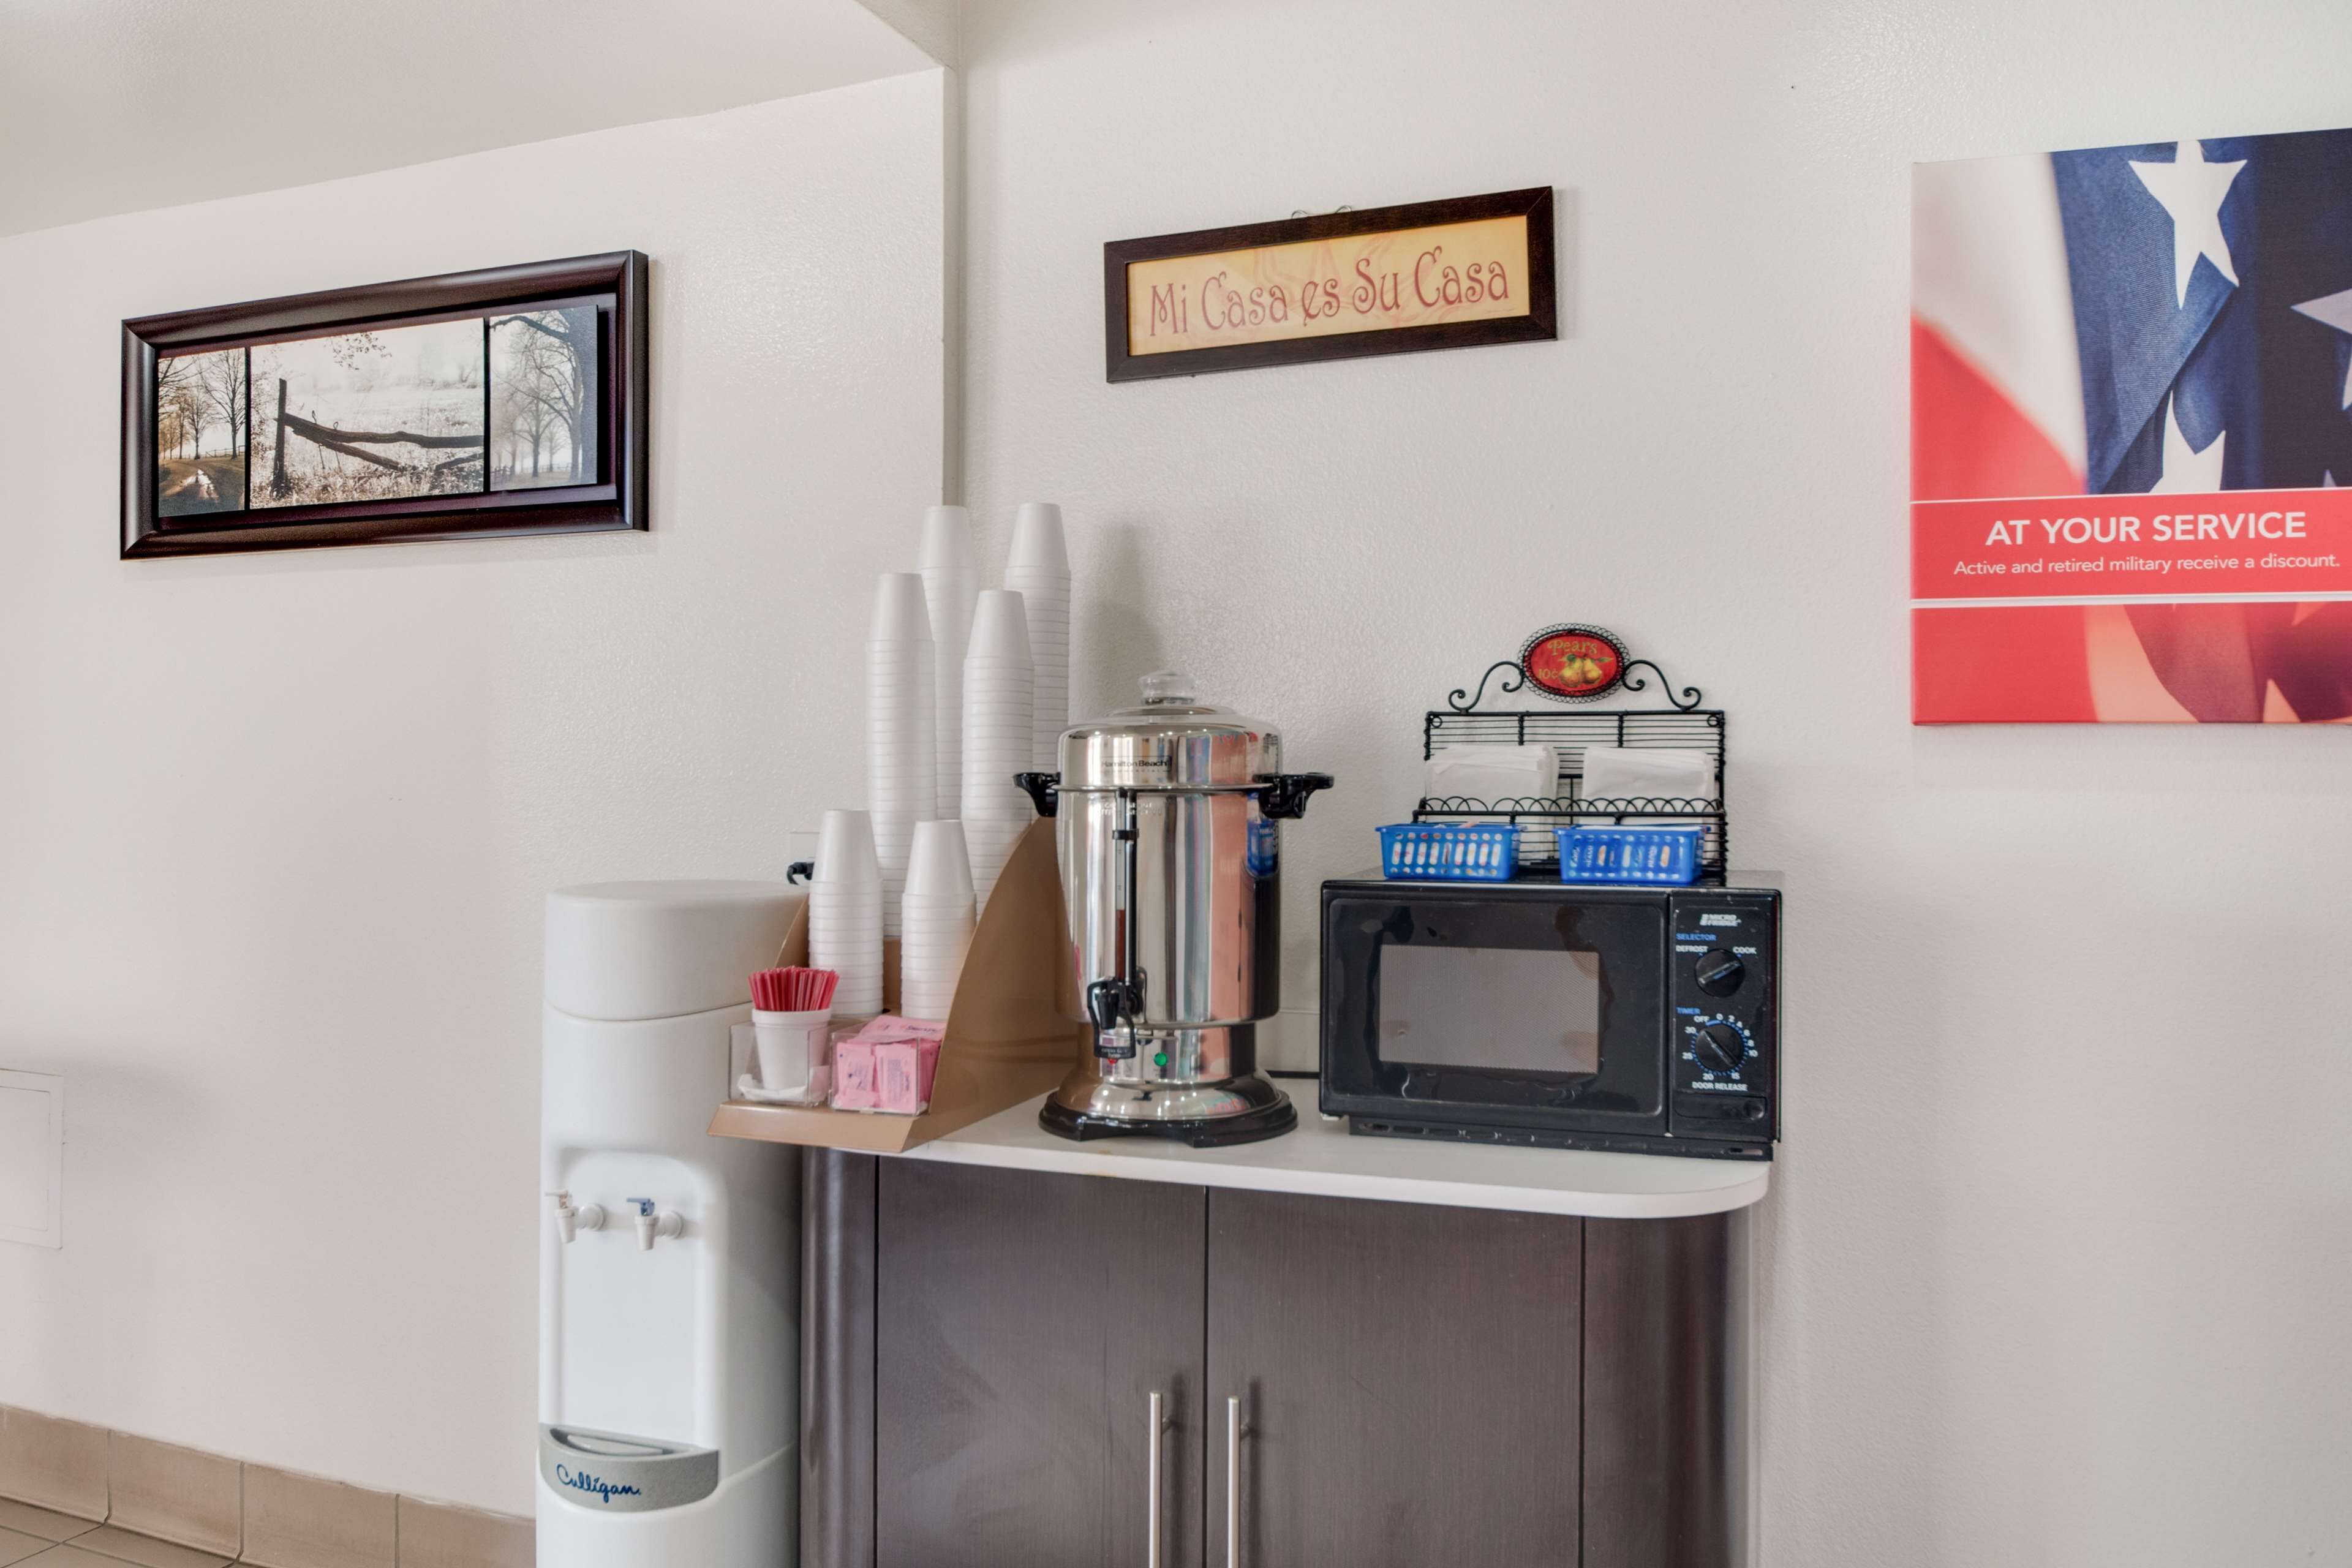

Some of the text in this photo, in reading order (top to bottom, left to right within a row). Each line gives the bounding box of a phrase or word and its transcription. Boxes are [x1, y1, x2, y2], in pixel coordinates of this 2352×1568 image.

[1150, 245, 1509, 336] Mi Casa es Su Casa
[1985, 511, 2307, 545] AT YOUR SERVICE
[1954, 553, 2340, 575] Active and retired military receive a discount.
[1547, 639, 1597, 656] Pears
[1714, 1083, 1748, 1091] RELEASE
